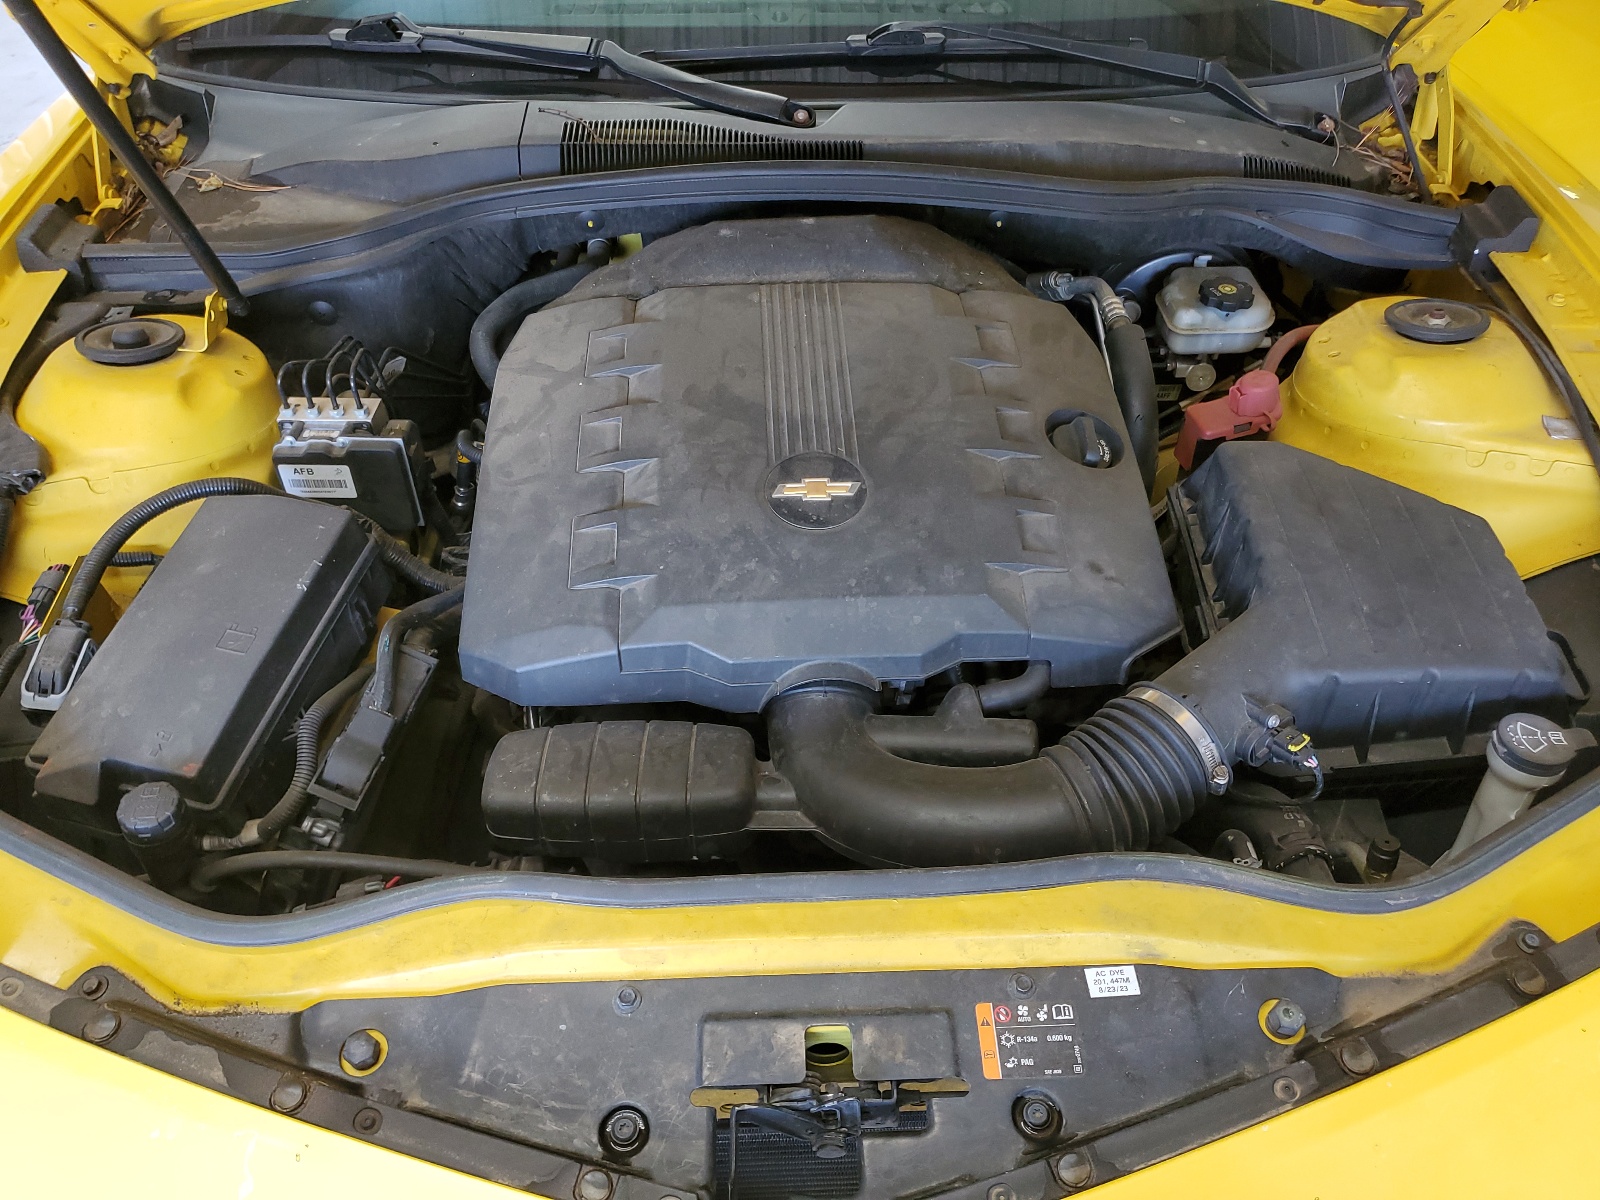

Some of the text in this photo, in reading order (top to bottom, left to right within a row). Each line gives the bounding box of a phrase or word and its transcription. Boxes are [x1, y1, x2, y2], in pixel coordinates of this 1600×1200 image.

[293, 467, 315, 476] AFB
[1098, 985, 1129, 994] 8/23/23
[1016, 1035, 1038, 1043] R-134a
[1064, 1034, 1072, 1042] kg
[1020, 1058, 1035, 1066] PAG
